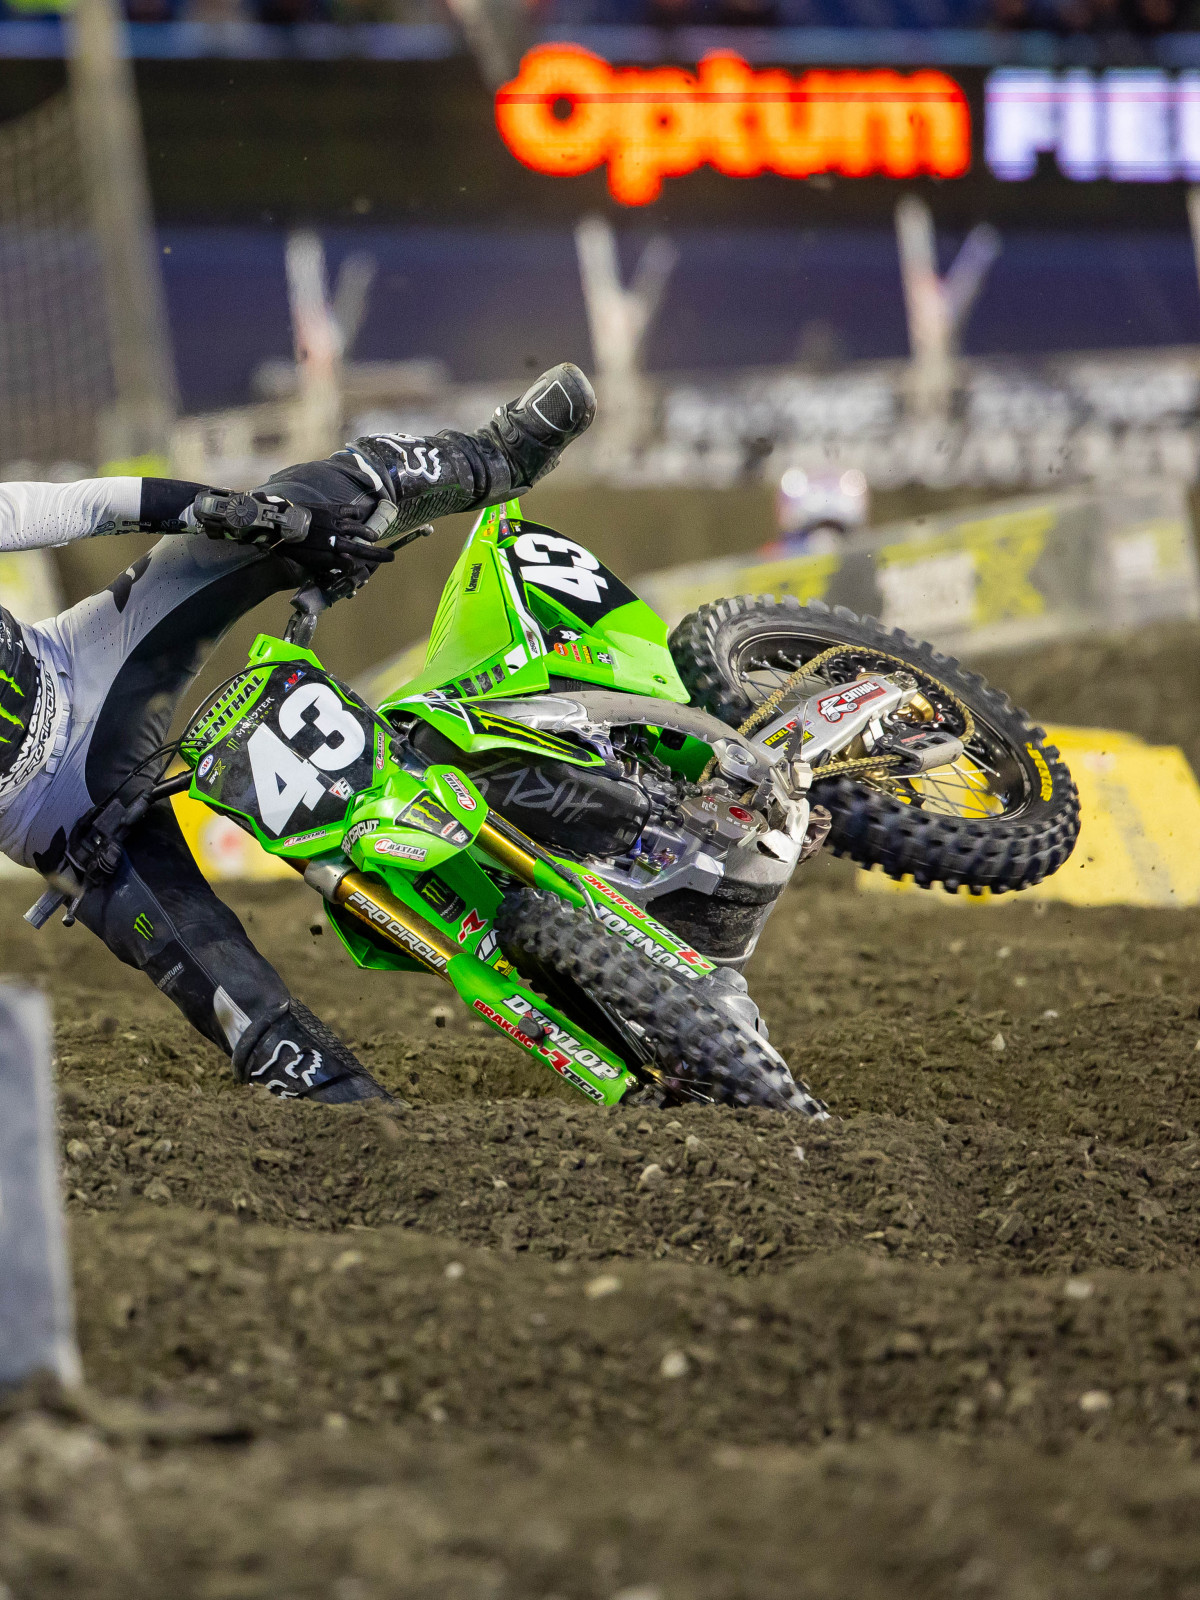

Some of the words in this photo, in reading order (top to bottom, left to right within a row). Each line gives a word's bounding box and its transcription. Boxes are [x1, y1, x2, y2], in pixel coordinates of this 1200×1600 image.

[495, 42, 973, 206] Optum
[465, 563, 483, 593] Kawasaki
[514, 533, 609, 603] 43
[284, 670, 306, 692] AMA
[820, 681, 880, 723] RENTHAL
[236, 696, 275, 738] MONSTER
[764, 728, 789, 747] EXCEL
[247, 683, 366, 836] 43
[349, 819, 380, 845] CIRCUIT
[387, 844, 427, 857] MAXIMA
[348, 891, 391, 925] PRO
[581, 874, 650, 920] BRAKING
[473, 998, 535, 1049] BRAKING
